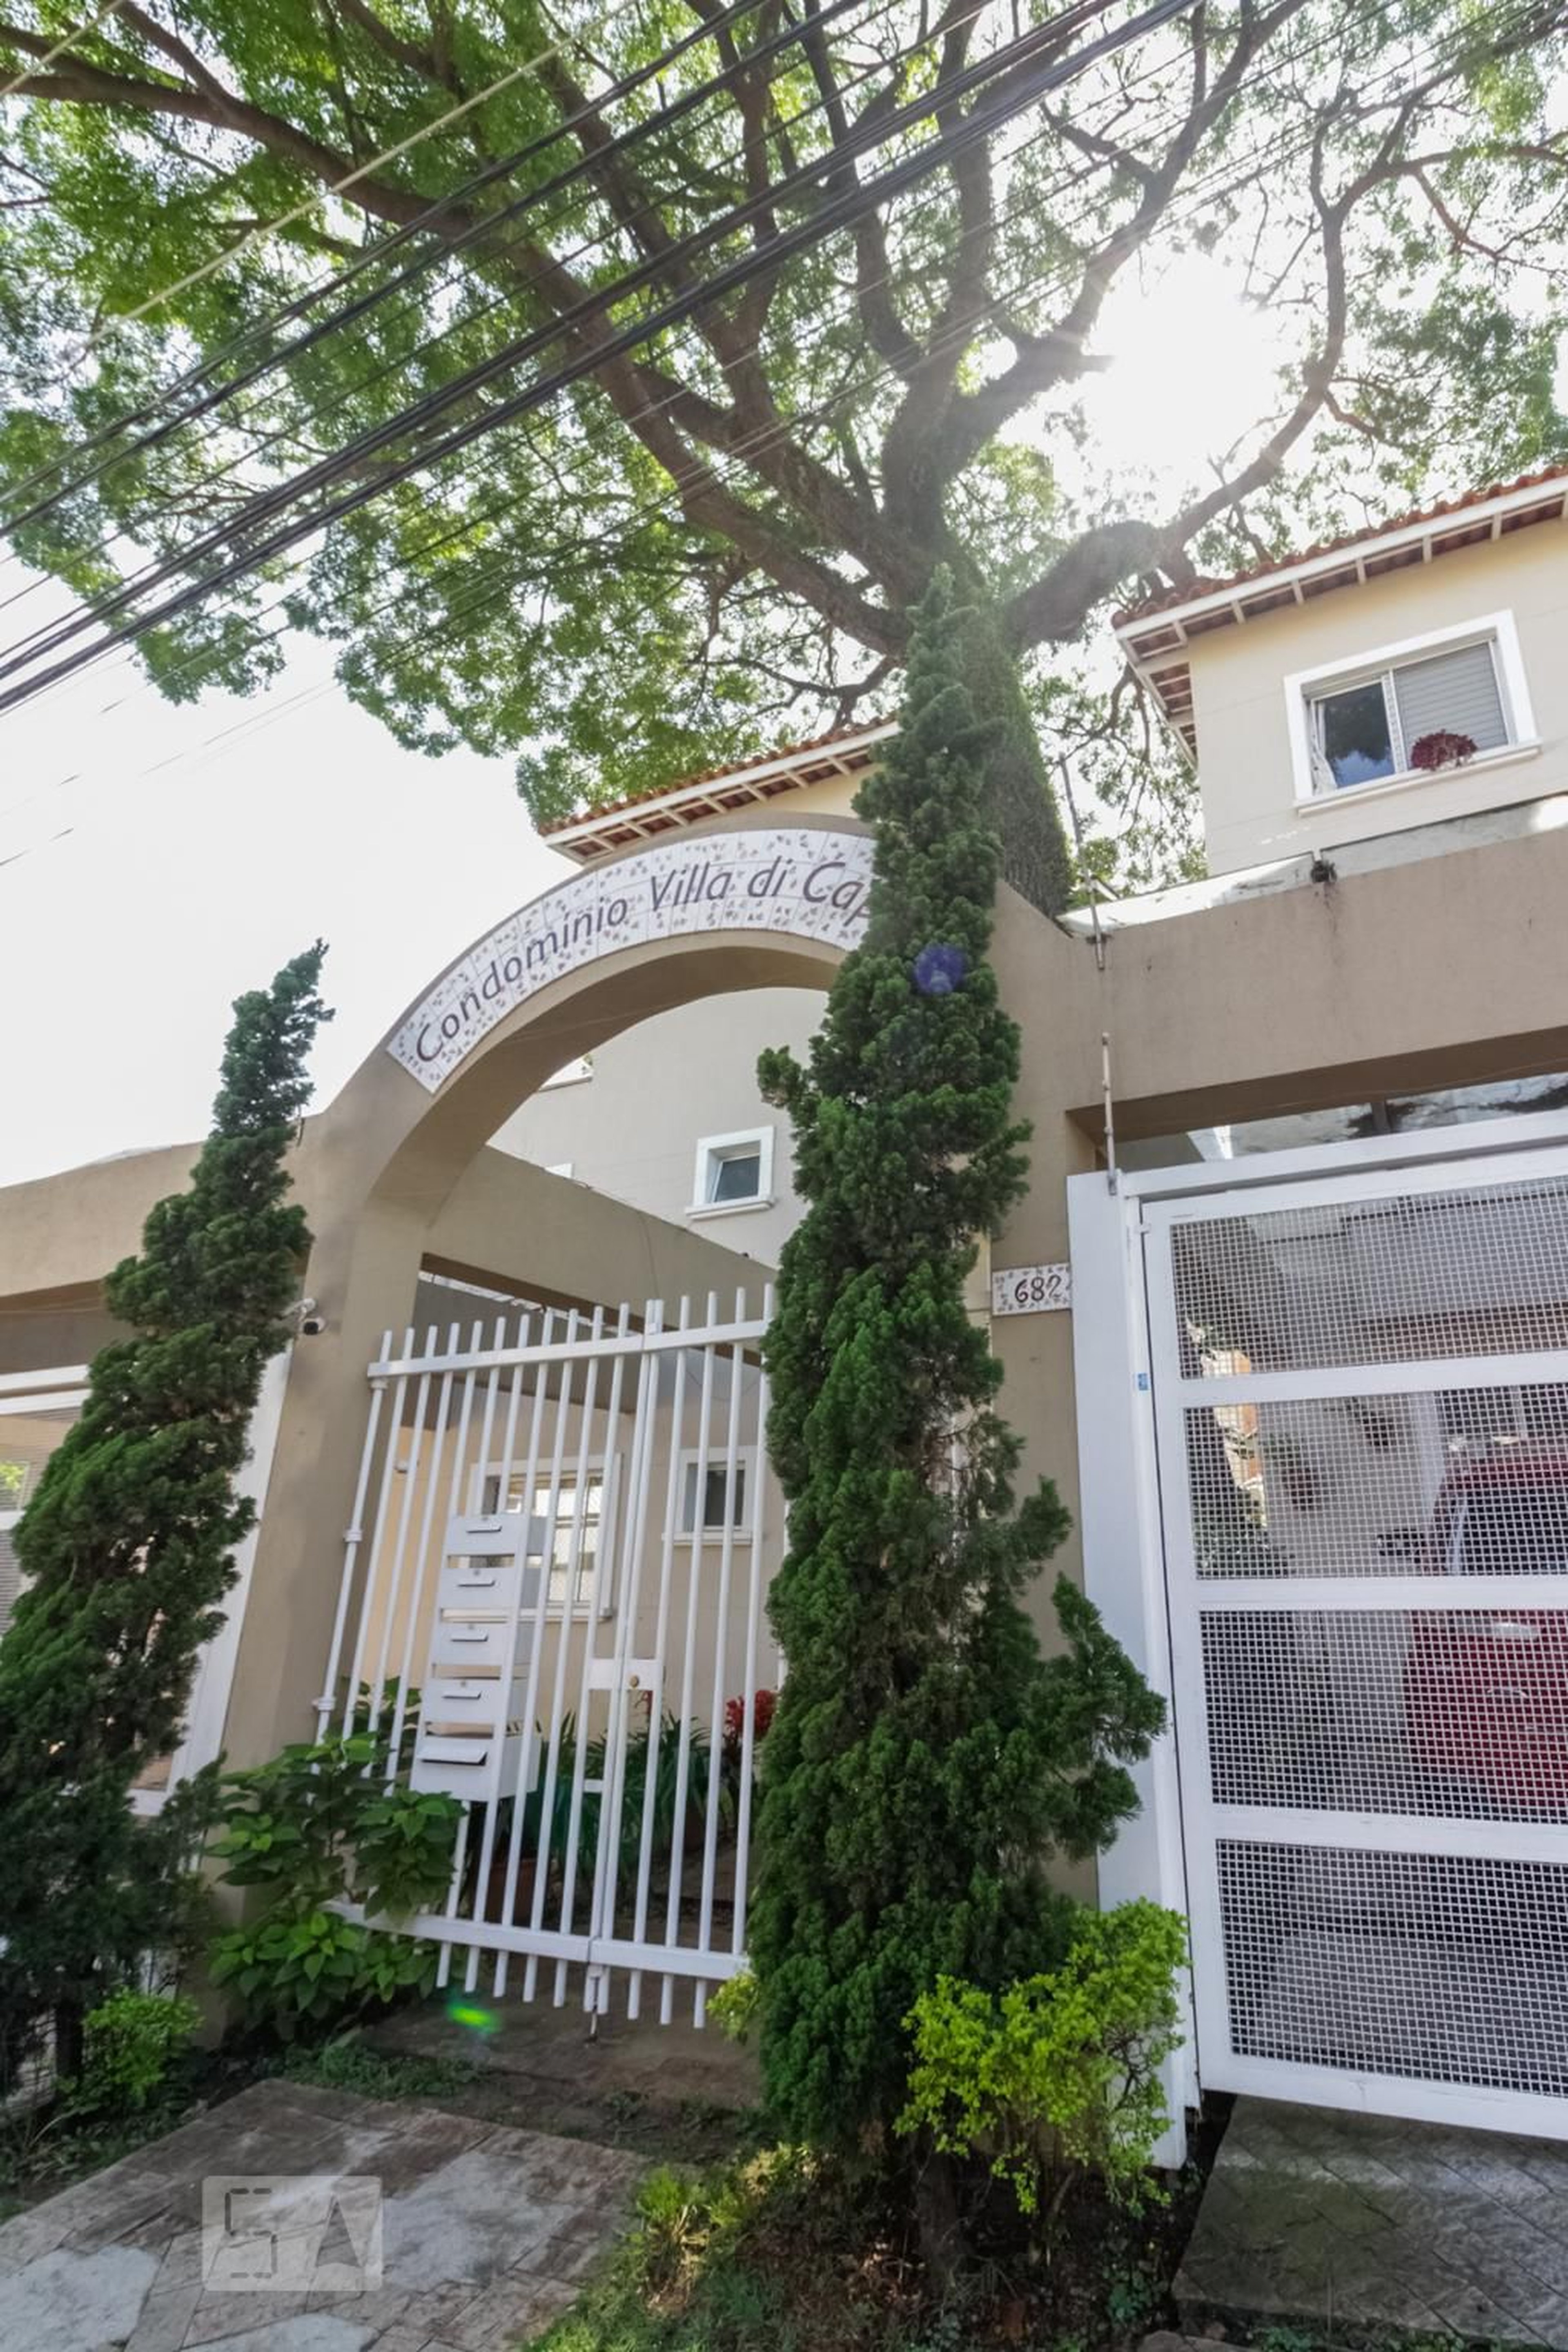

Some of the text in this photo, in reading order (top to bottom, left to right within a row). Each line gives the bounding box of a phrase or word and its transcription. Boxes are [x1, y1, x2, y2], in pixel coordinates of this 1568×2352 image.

[651, 861, 733, 911] Villa
[747, 856, 793, 897] di
[1015, 1274, 1061, 1303] 682
